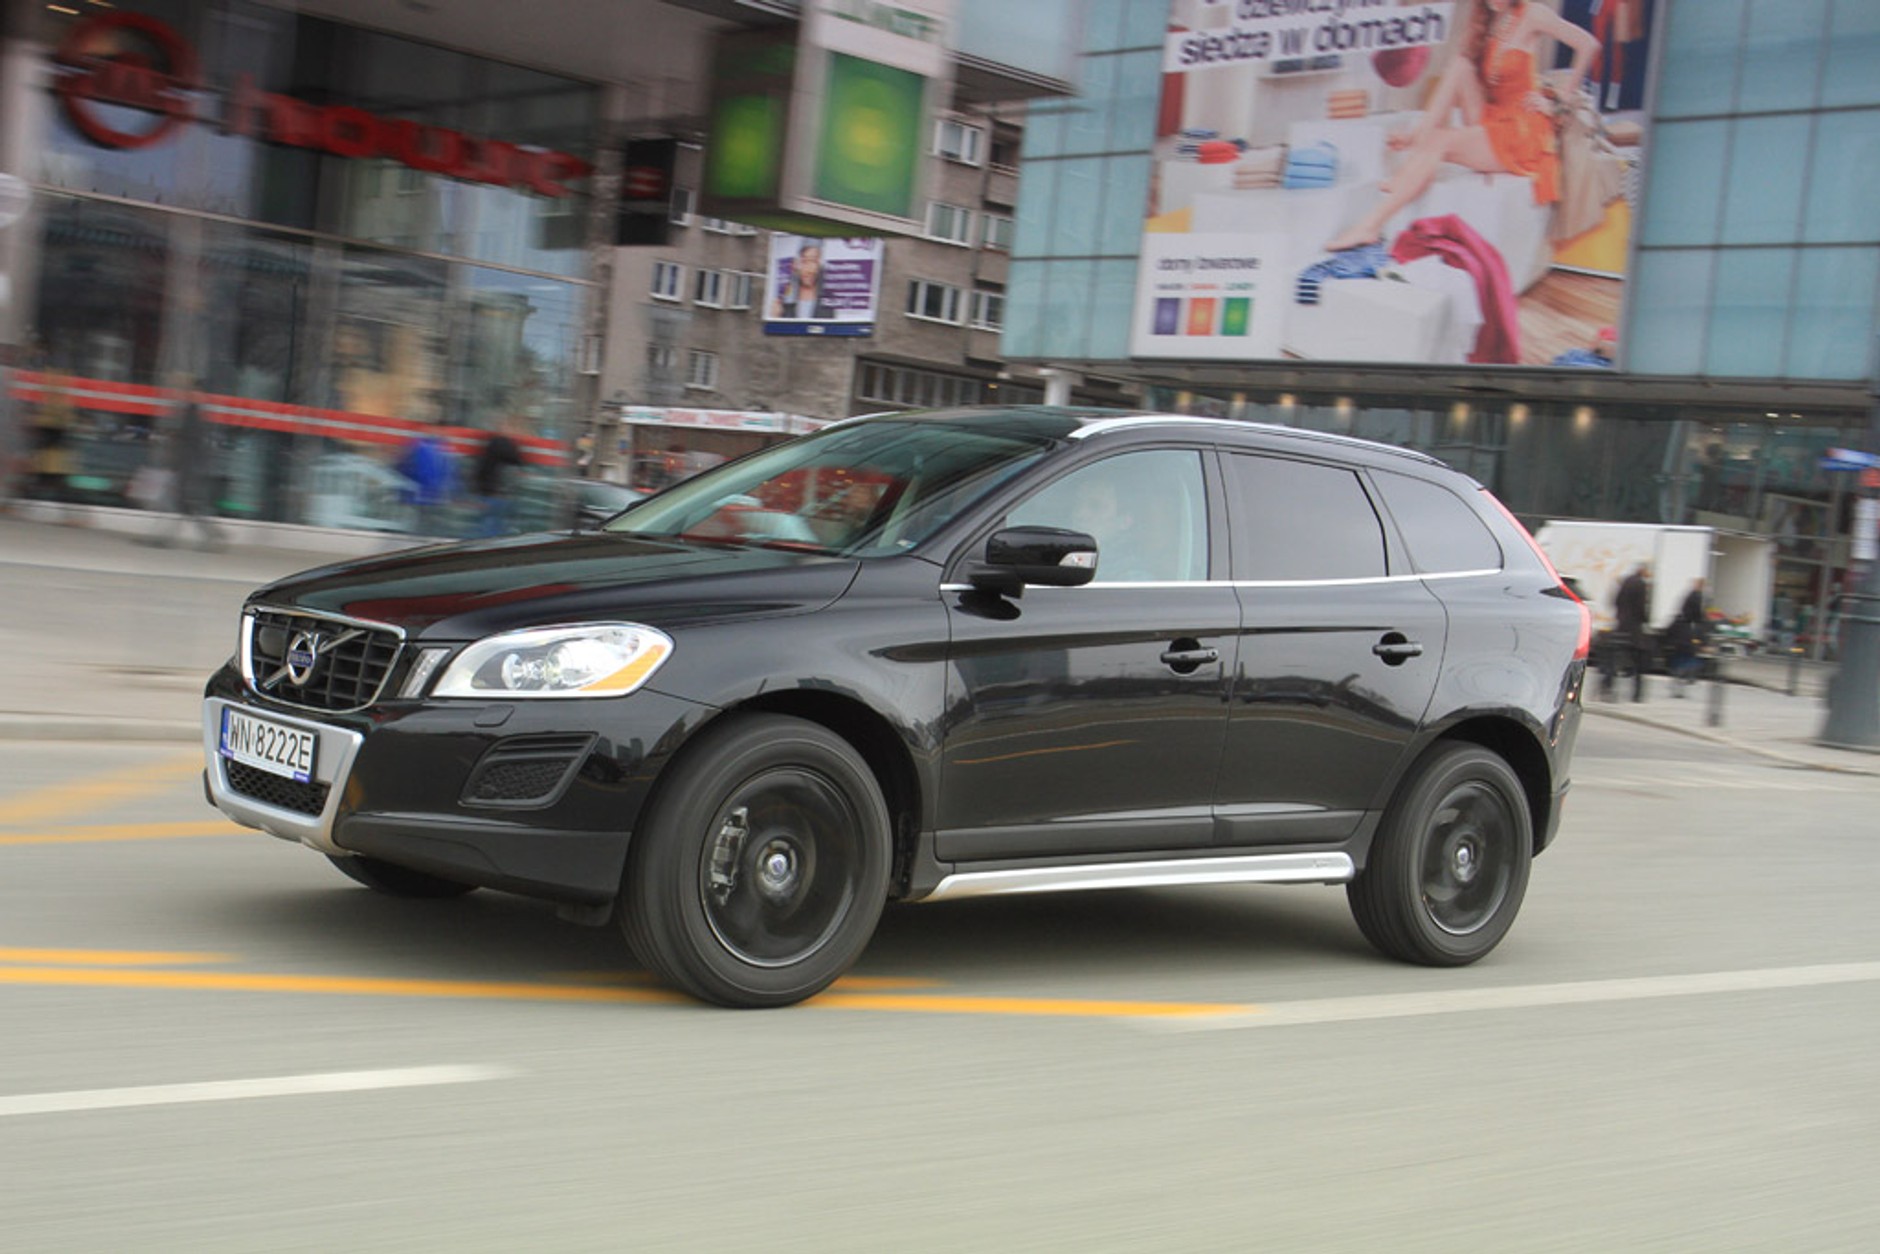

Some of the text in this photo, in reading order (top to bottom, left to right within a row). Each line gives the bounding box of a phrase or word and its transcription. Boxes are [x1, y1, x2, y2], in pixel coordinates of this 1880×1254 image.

[1278, 28, 1310, 56] w
[1314, 7, 1445, 52] domach
[229, 713, 312, 772] WN 8222E
